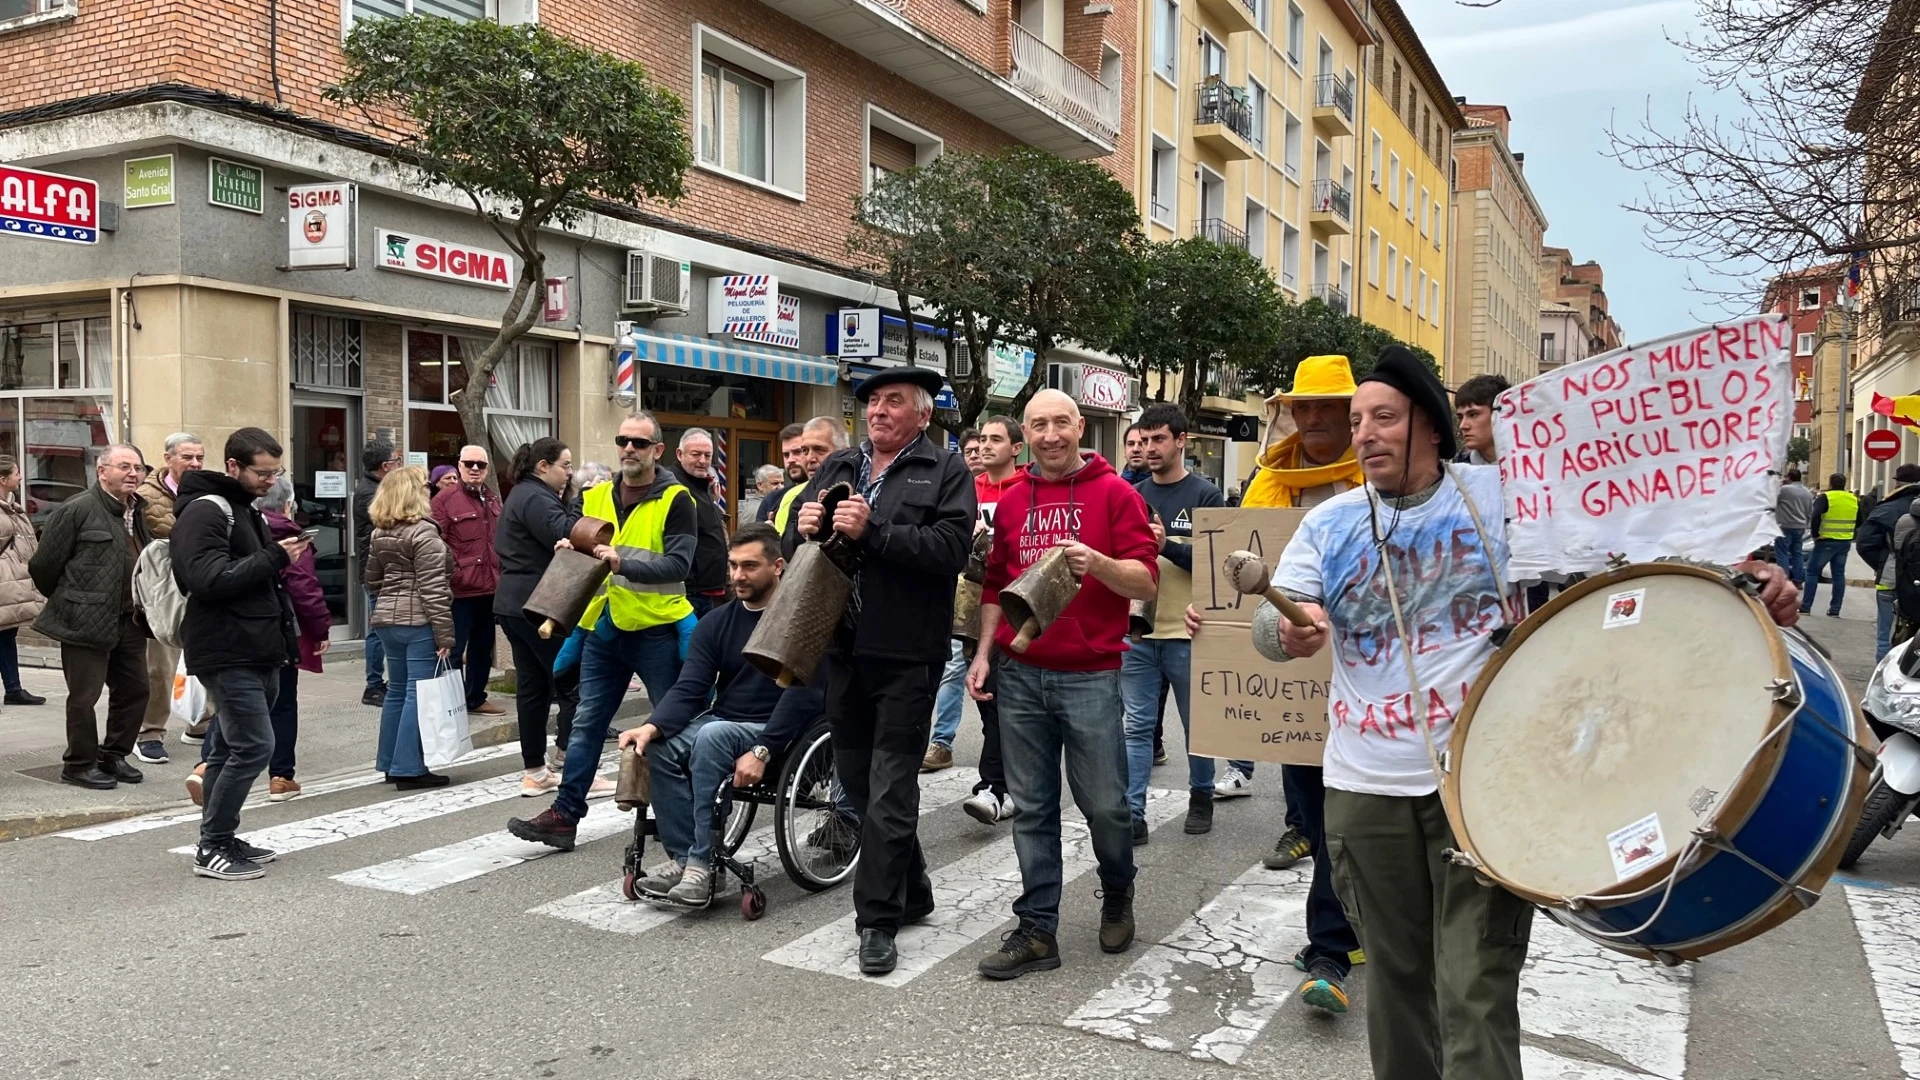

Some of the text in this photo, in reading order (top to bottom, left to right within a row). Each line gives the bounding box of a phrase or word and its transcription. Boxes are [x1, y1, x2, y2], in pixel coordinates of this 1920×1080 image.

[139, 167, 169, 179] Avenida
[236, 167, 256, 180] Calle
[126, 183, 171, 199] Santo Grial
[218, 175, 256, 195] GENERAL
[1, 176, 91, 222] ALFA
[217, 189, 259, 209] LASHERAS
[289, 190, 342, 209] SIGMA
[415, 243, 508, 284] SIGMA
[724, 287, 747, 299] Miguel
[919, 348, 939, 362] Estado
[1500, 320, 1786, 419] SE NOS MUEREN
[1092, 382, 1114, 401] ISA
[1512, 364, 1771, 449] LOS PUEBLOS
[1021, 508, 1082, 533] ALWAYS
[1020, 533, 1050, 547] BELIEVE
[1053, 534, 1061, 545] IN
[1283, 712, 1304, 722] ES
[1262, 731, 1323, 743] DEMAS
